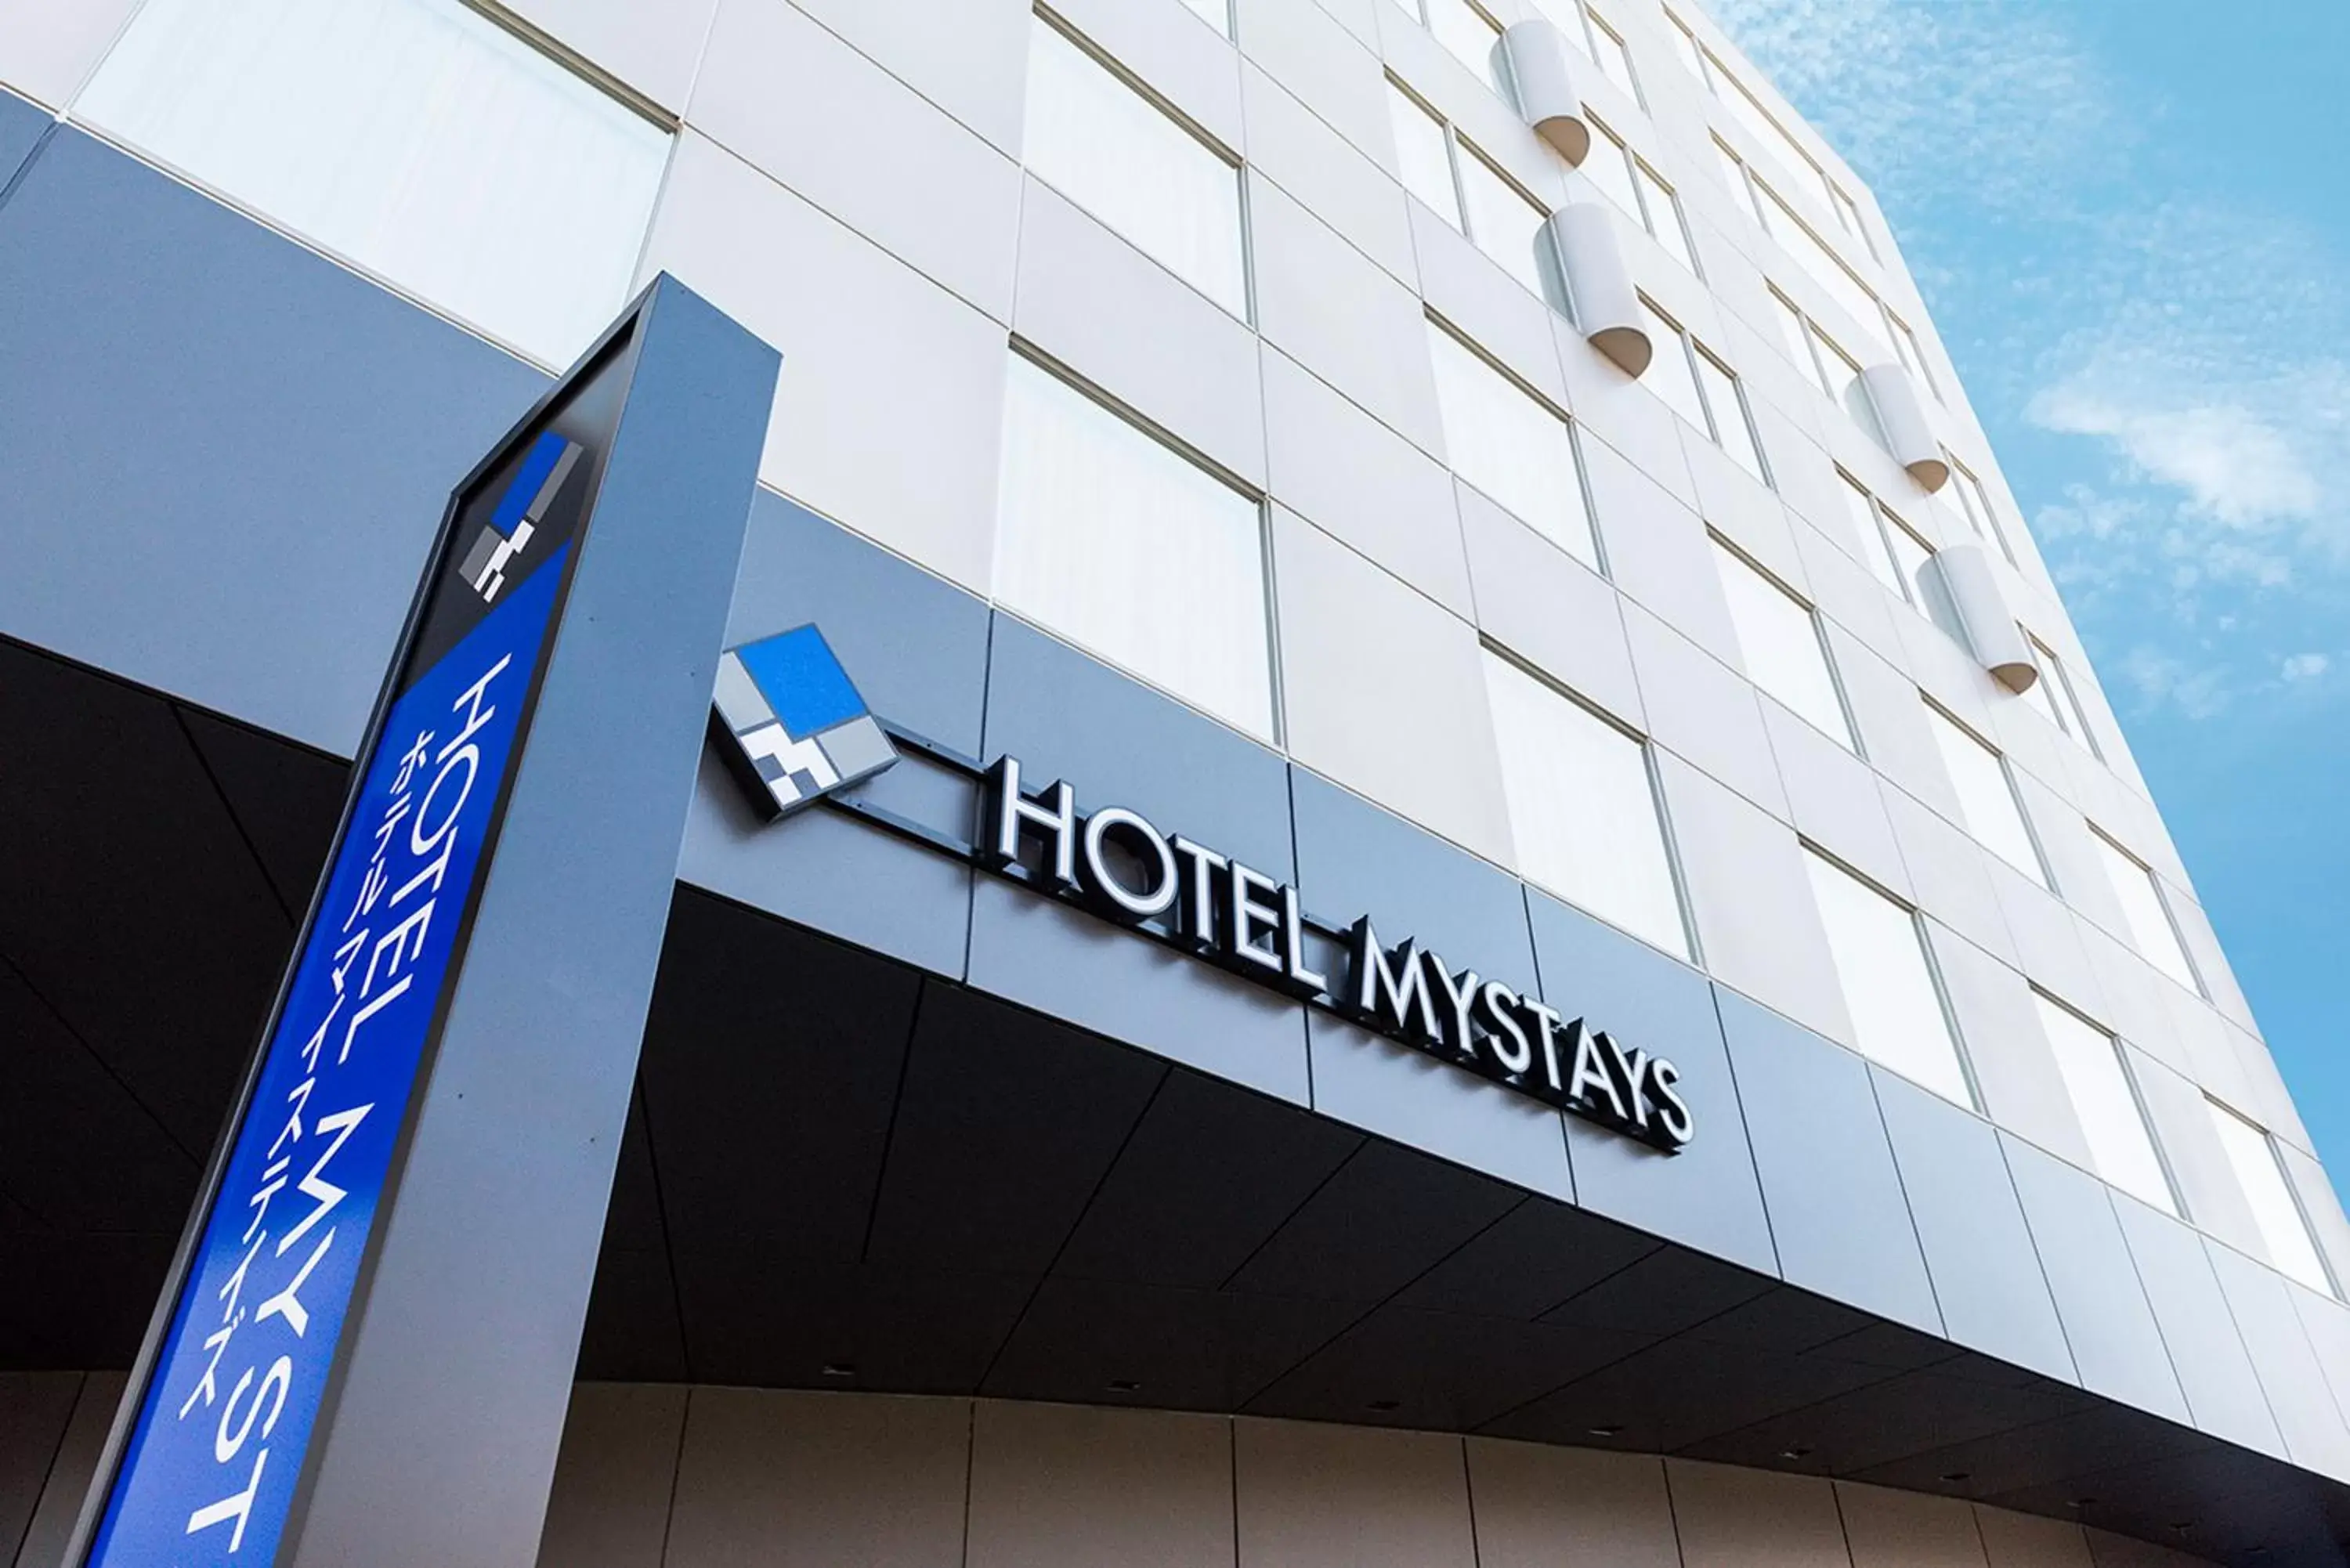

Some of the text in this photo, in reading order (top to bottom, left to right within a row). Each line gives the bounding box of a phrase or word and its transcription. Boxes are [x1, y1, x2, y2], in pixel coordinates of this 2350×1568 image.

[341, 652, 512, 1065] HOTEL
[995, 753, 1696, 1148] HOTEL MYSTAYS
